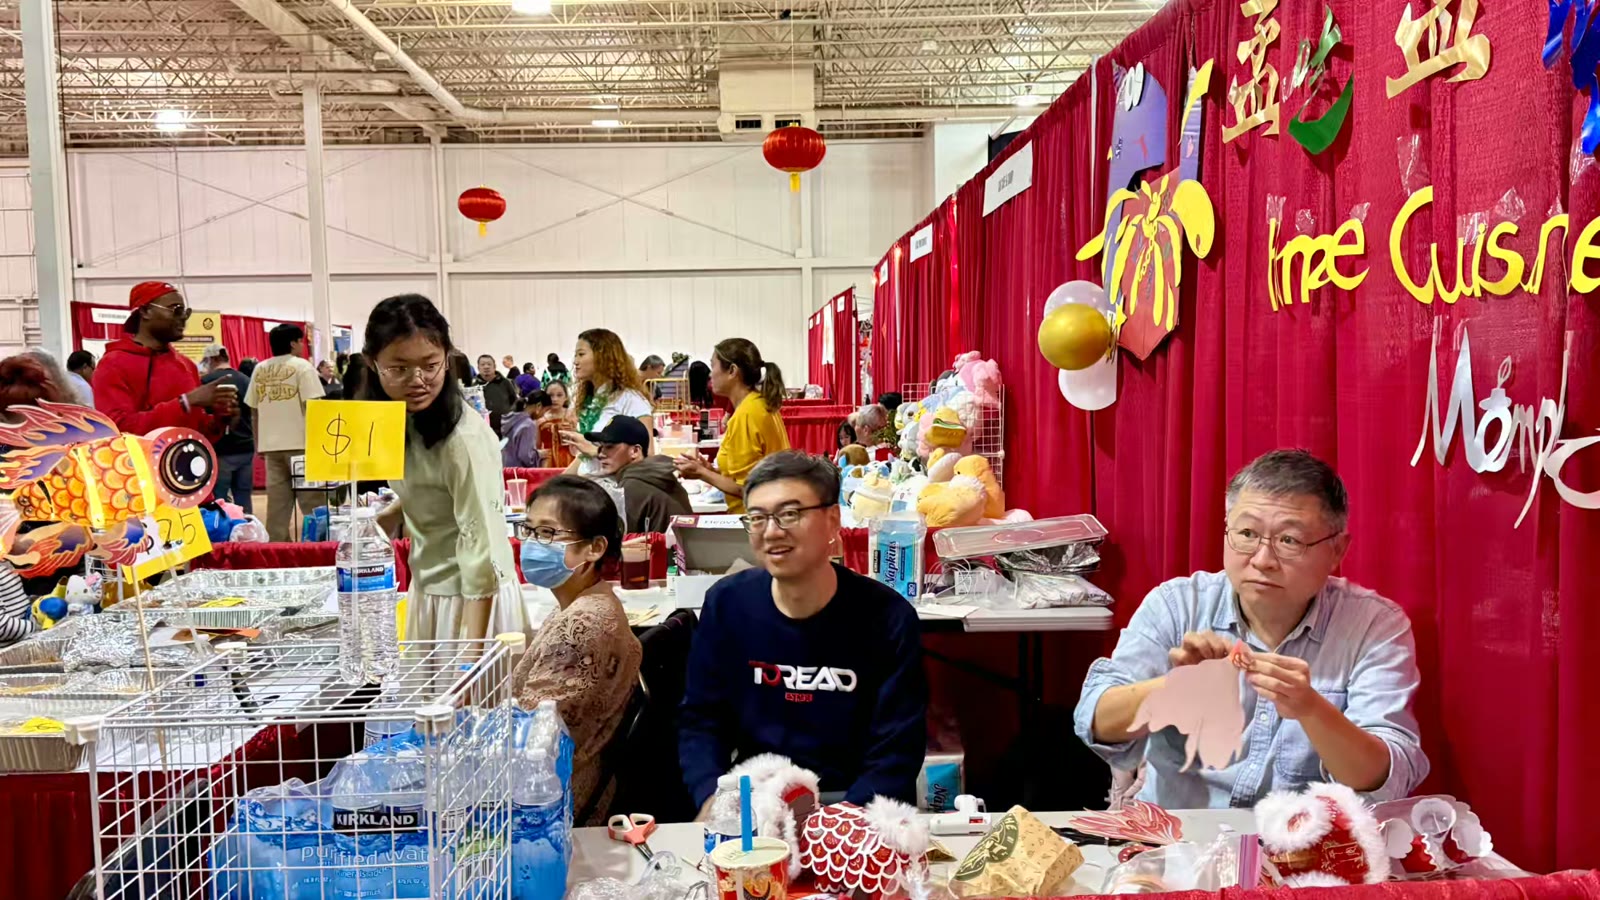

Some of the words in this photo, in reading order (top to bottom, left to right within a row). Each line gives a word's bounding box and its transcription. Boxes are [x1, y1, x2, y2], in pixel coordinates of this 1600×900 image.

[1389, 185, 1600, 304] Cuisne
[353, 566, 384, 575] RKLAND
[884, 541, 899, 588] Napkins
[749, 660, 857, 692] TOREAD
[336, 814, 415, 826] KIRKLAND
[301, 846, 378, 867] purified
[386, 847, 430, 862] wat
